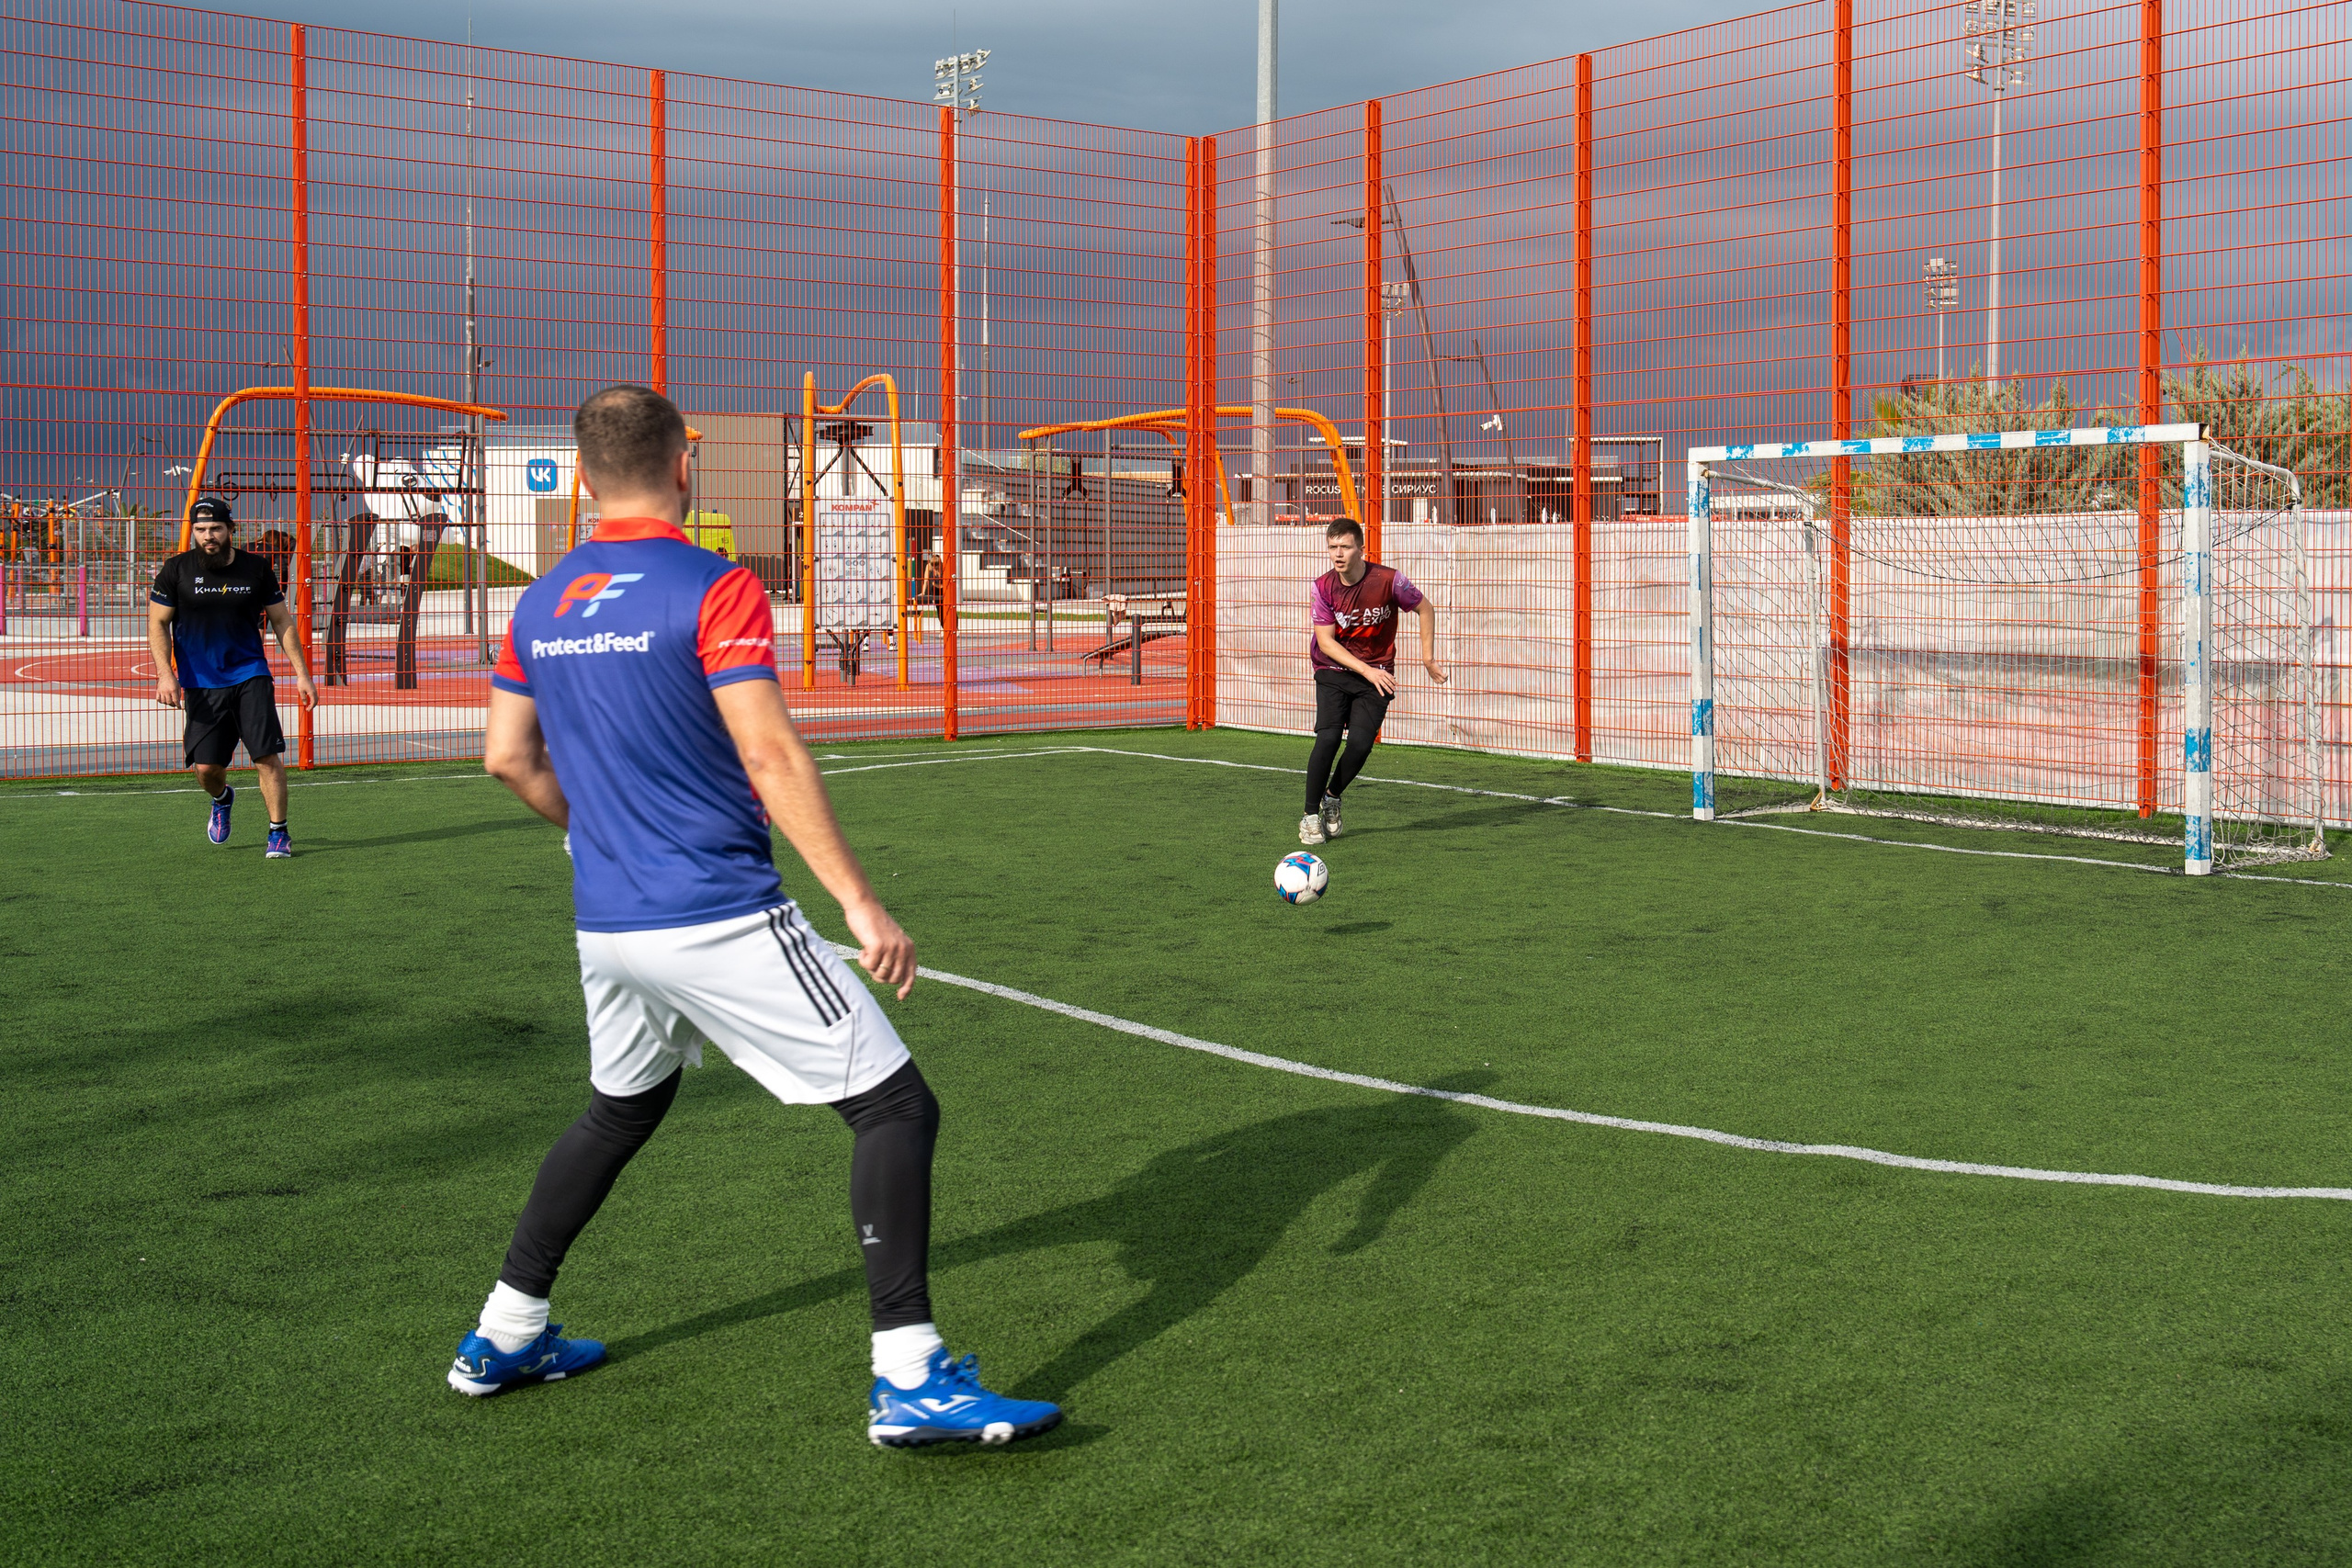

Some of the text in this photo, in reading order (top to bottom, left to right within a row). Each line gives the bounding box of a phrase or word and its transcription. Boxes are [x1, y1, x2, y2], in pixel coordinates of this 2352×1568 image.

[530, 467, 551, 483] VK
[1306, 485, 1341, 494] ROCUS
[1391, 484, 1437, 494] СИРИУС
[1363, 604, 1389, 617] ASIA
[1363, 611, 1391, 626] EXPO
